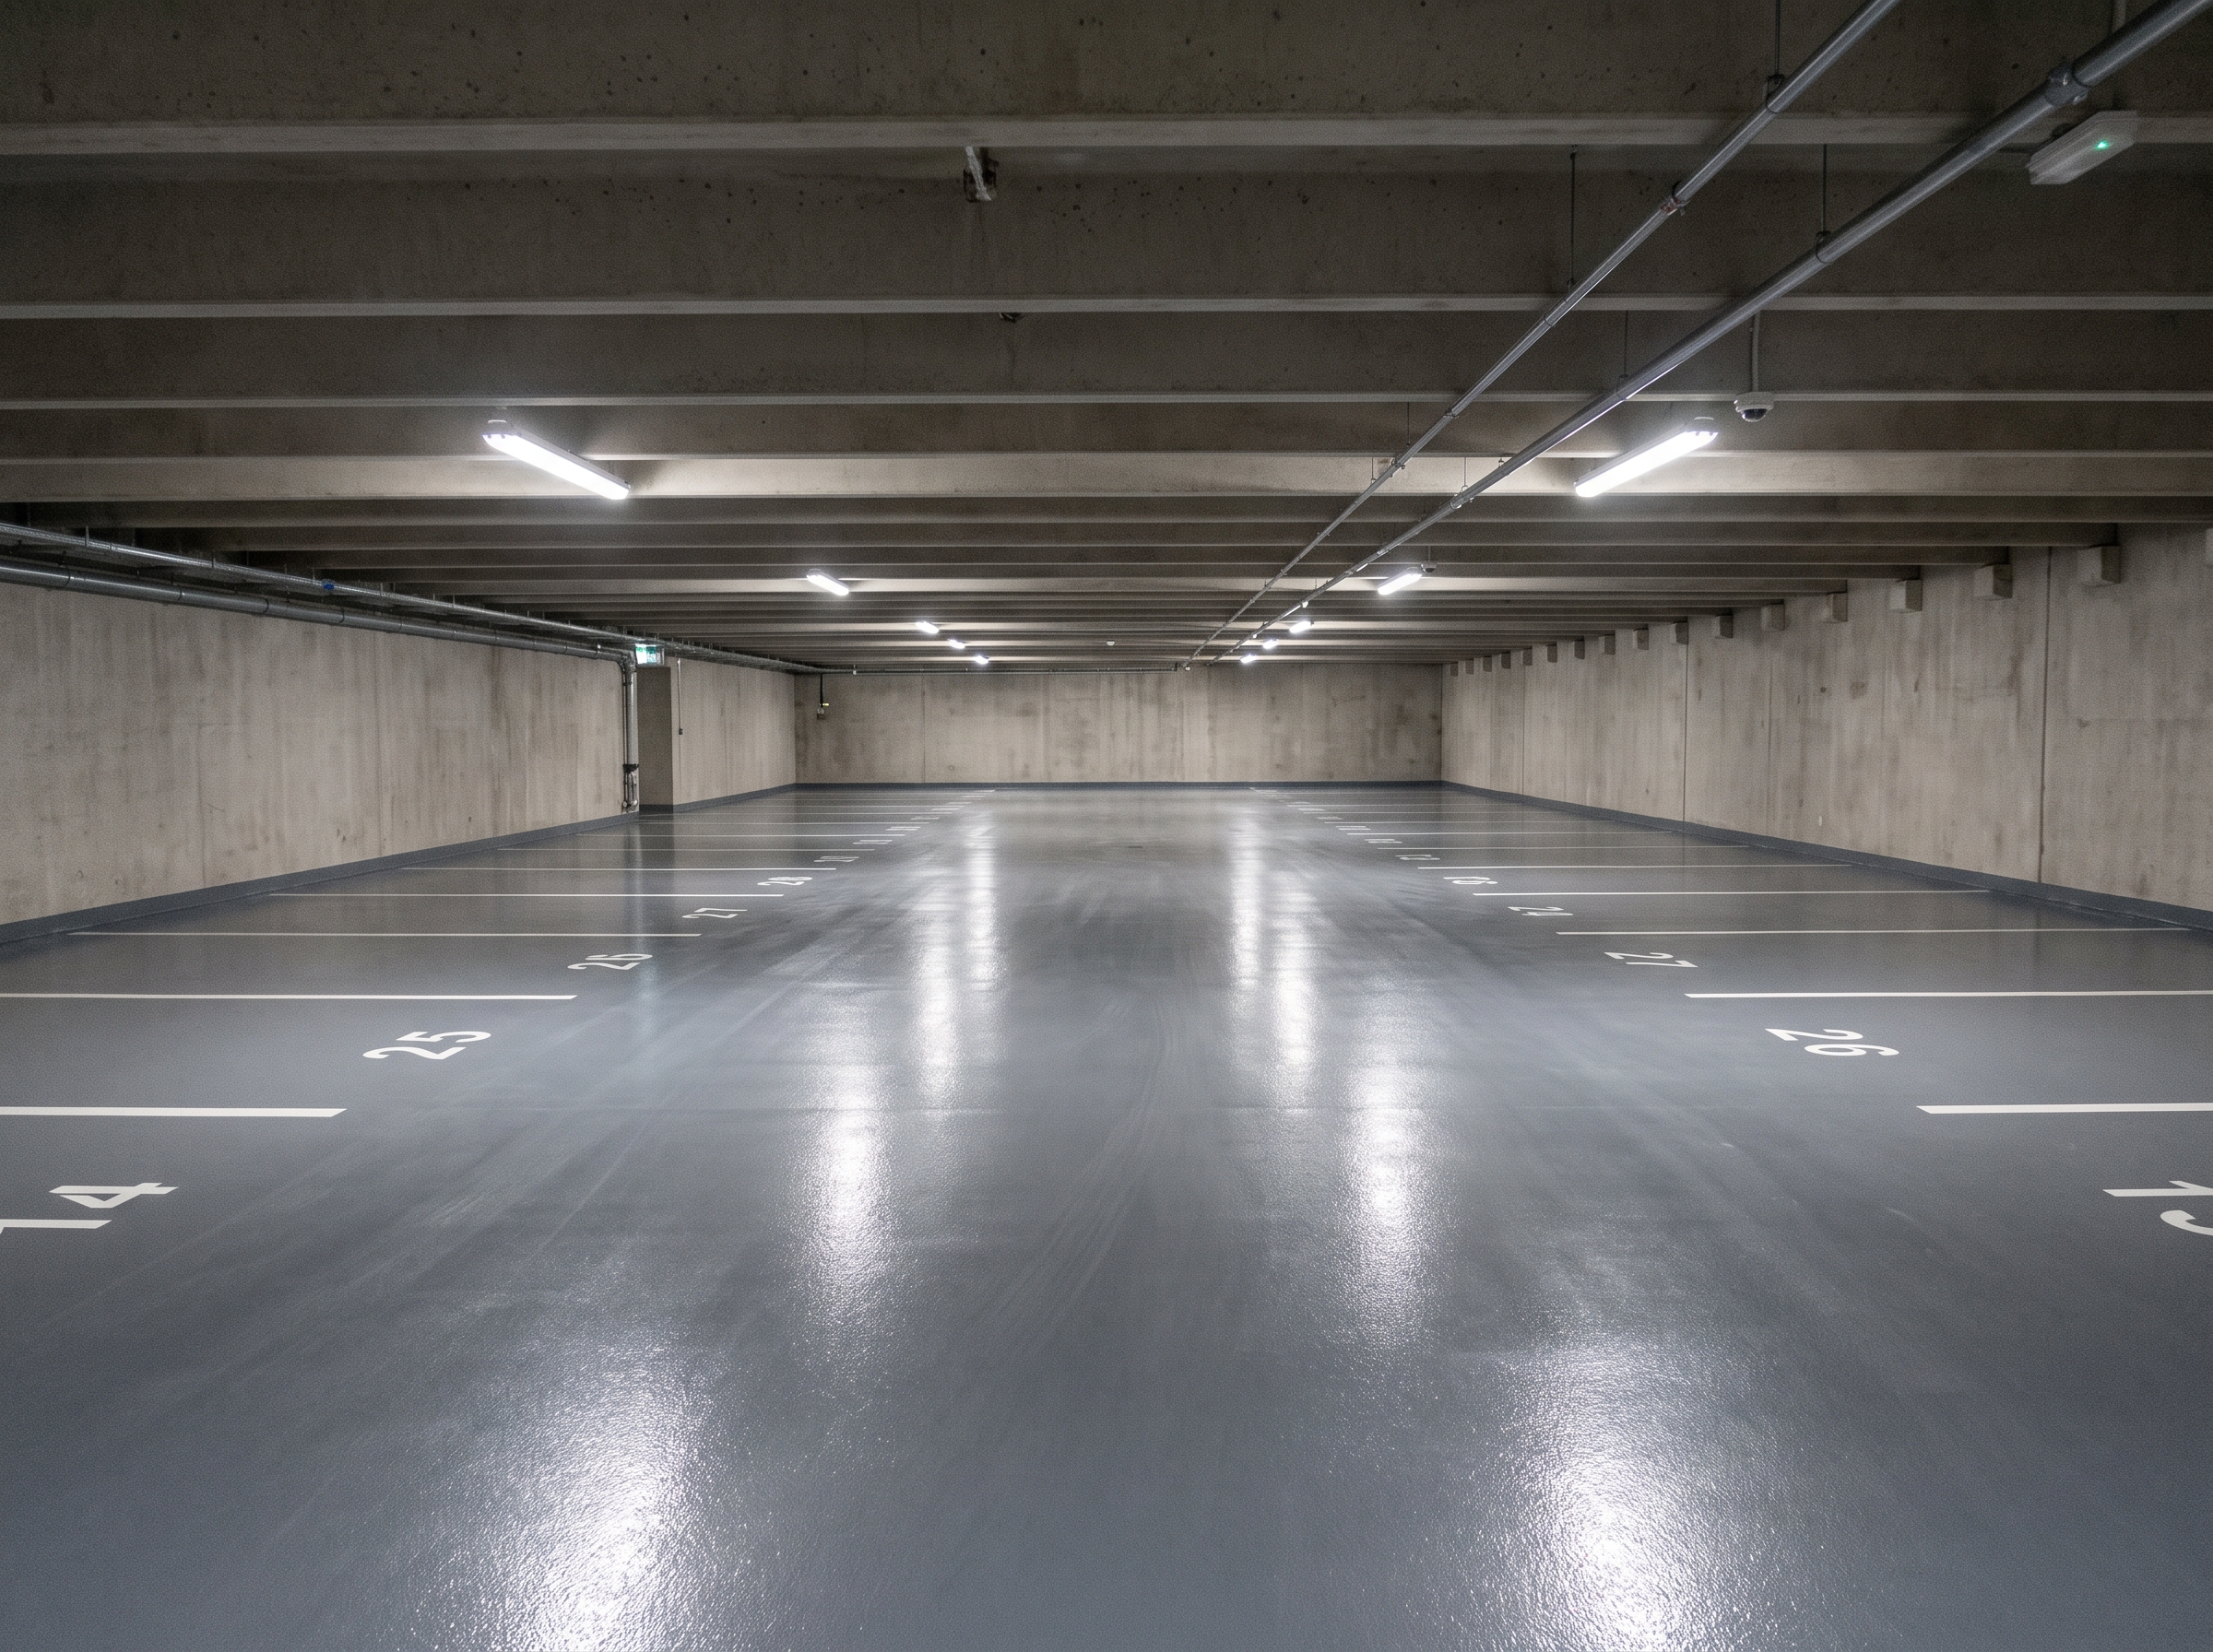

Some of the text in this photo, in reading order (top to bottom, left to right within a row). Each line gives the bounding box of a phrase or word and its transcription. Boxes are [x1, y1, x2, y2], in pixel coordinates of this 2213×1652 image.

[681, 907, 748, 919] 27
[567, 953, 653, 971] 26
[1604, 951, 1698, 968] 27
[362, 1031, 491, 1060] 25
[1764, 1028, 1899, 1056] 26
